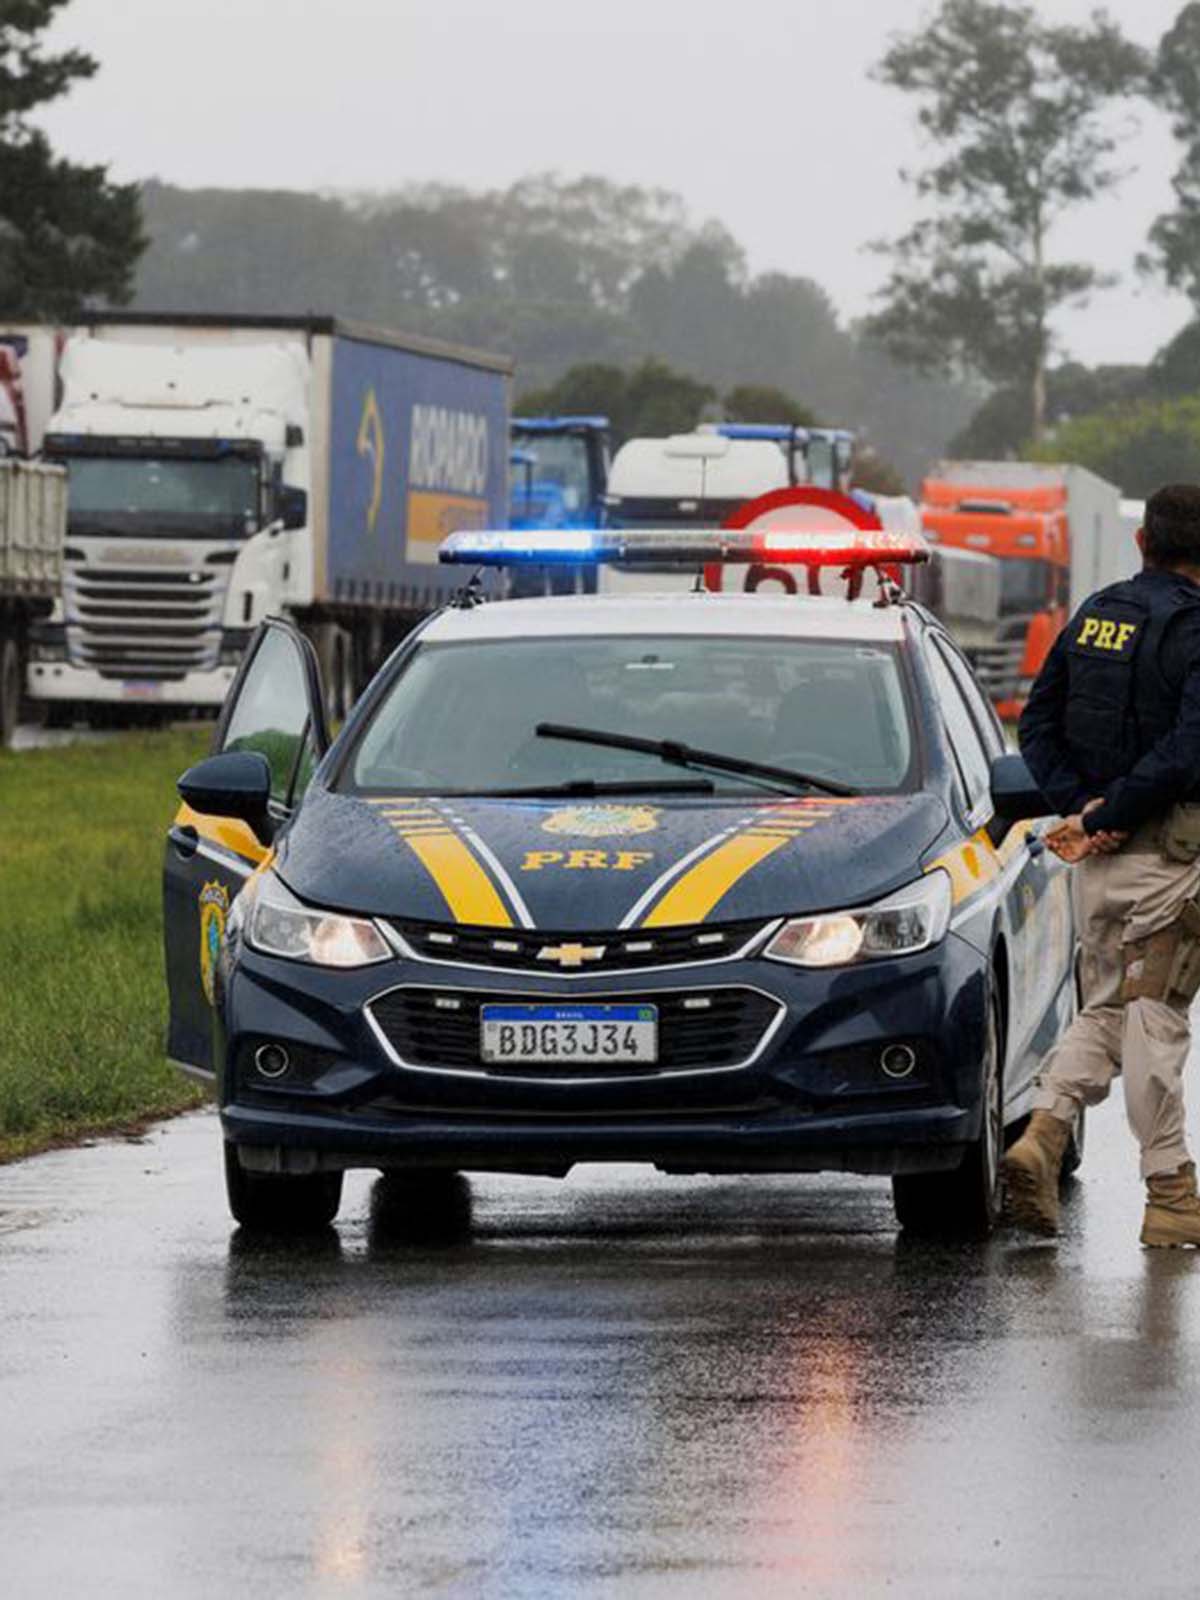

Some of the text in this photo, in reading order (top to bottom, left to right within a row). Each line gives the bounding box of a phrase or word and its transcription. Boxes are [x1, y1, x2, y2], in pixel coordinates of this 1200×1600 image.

[1077, 618, 1136, 650] PRF
[520, 850, 654, 871] PRF
[499, 1023, 638, 1055] BDG3J34
